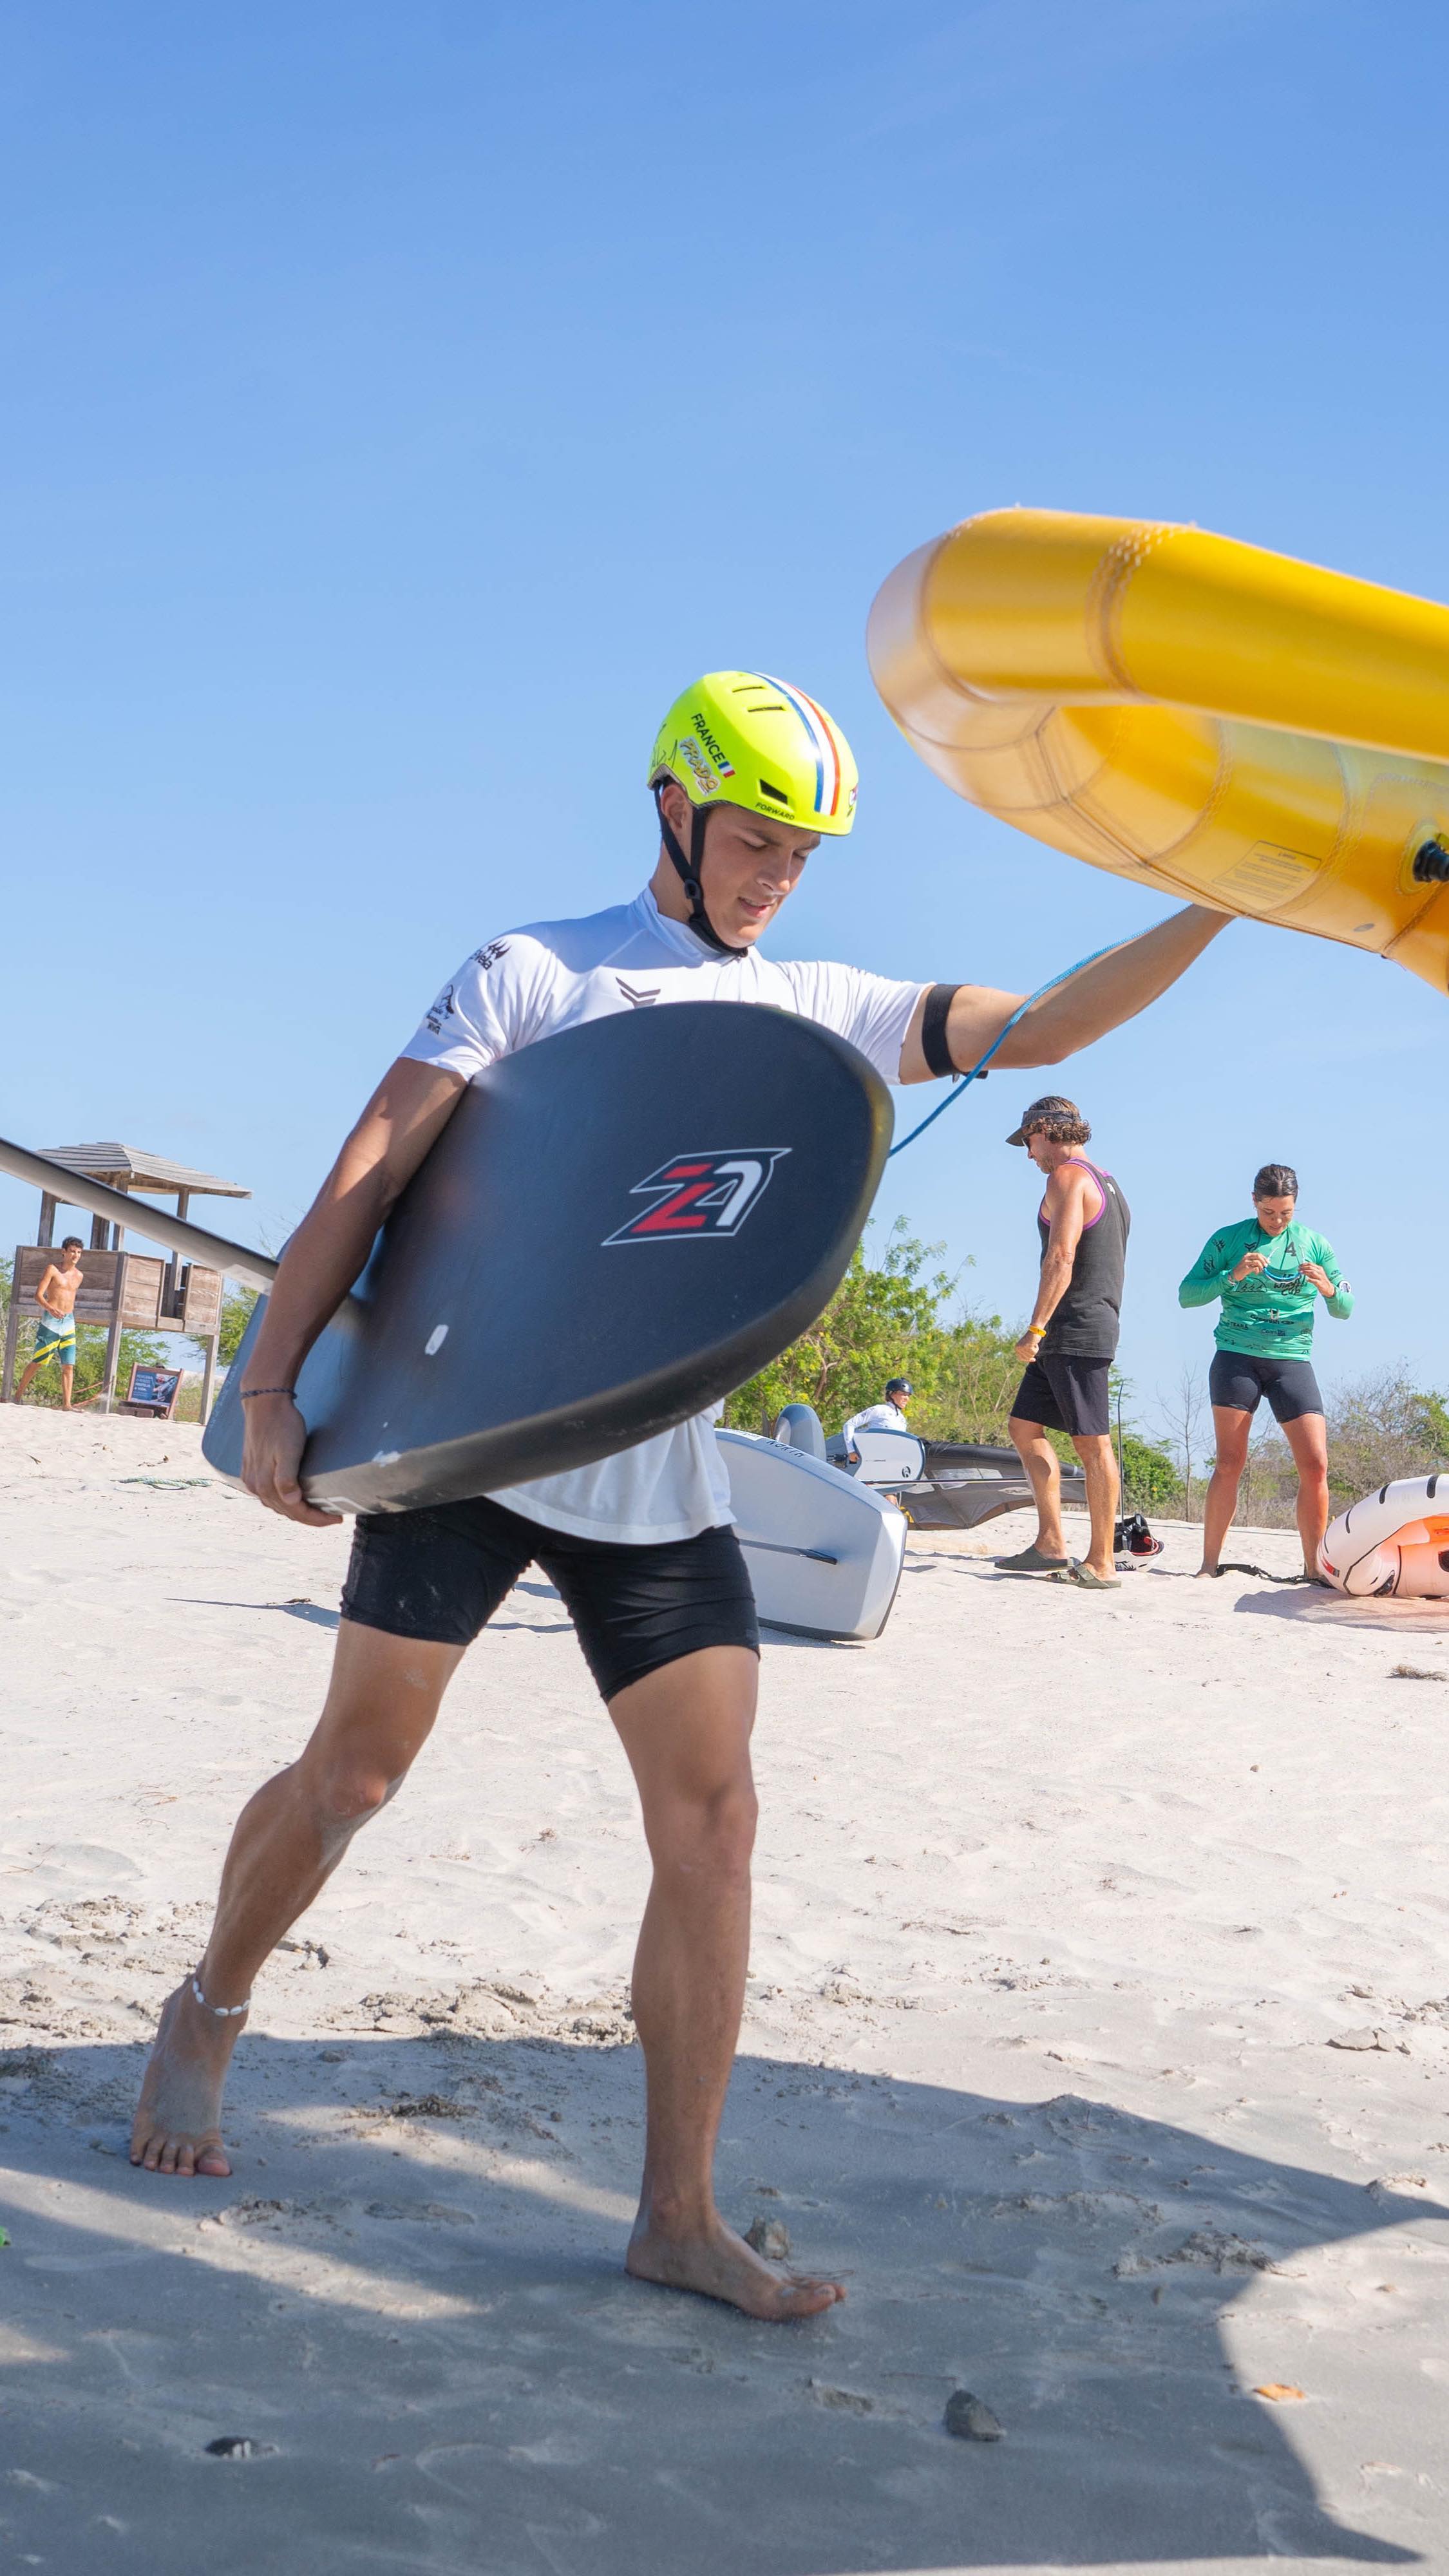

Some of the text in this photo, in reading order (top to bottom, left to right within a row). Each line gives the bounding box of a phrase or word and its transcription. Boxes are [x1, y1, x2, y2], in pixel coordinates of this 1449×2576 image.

[691, 713, 726, 763] FRANCE
[755, 802, 795, 821] FORWARD
[766, 1440, 808, 1457] NORTH
